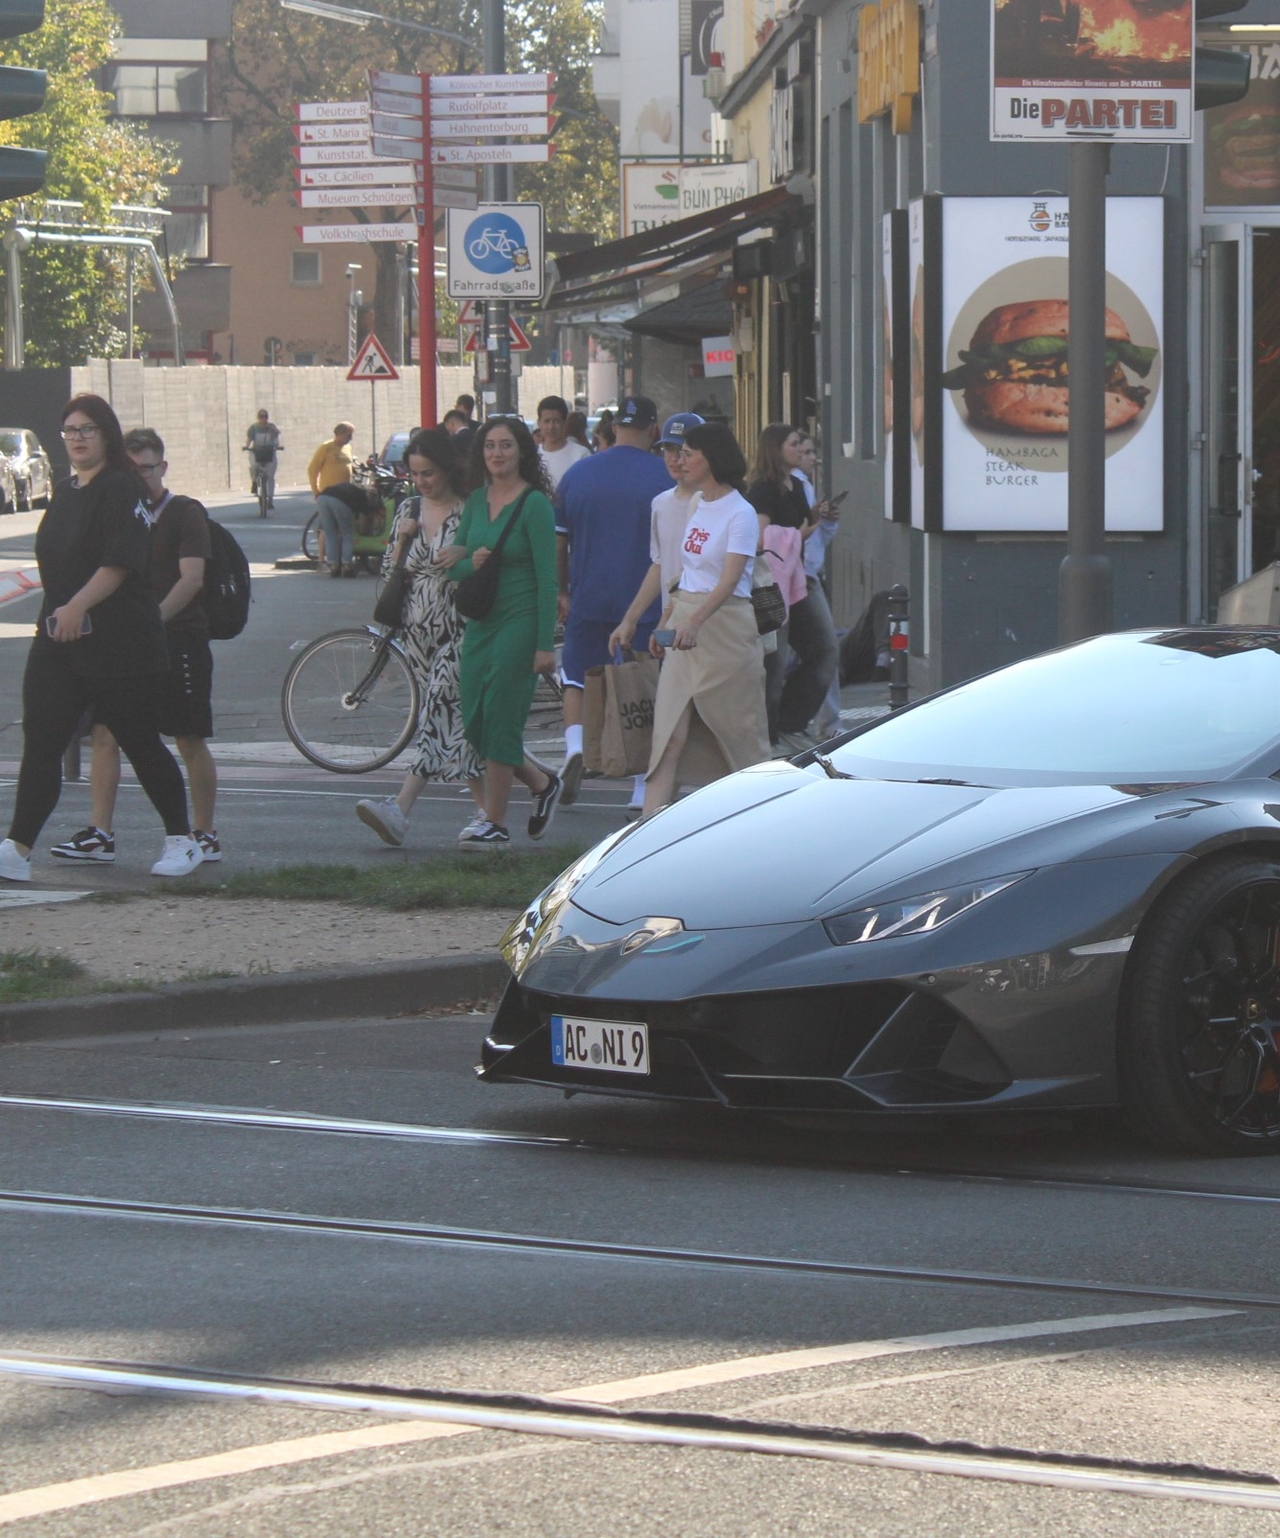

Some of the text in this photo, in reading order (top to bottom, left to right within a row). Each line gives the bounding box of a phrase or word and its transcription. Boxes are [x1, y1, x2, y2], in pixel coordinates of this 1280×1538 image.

[449, 79, 545, 90] Kölnischer Kunstverein
[316, 106, 358, 117] Deutzer
[449, 100, 508, 113] Rudolfplatz
[1010, 97, 1177, 129] Die PARTEI
[449, 121, 529, 133] Hahnentorburg
[317, 128, 330, 139] St.
[332, 128, 360, 139] Maria
[316, 149, 369, 160] Kunststat.
[450, 148, 512, 161] St. Aposteln
[317, 170, 374, 183] St. Cäcilien
[318, 191, 413, 205] Museum Schnütgen
[682, 181, 711, 210] BÚN
[1054, 212, 1069, 221] HA
[320, 226, 405, 240] Volkshochschule
[453, 279, 536, 291] Fahrradsaße
[985, 447, 1059, 458] HAMBAGA
[985, 461, 1027, 472] STEAK
[985, 475, 1039, 486] BURGER
[624, 712, 654, 730] JON
[565, 1023, 645, 1068] AC NI 9
